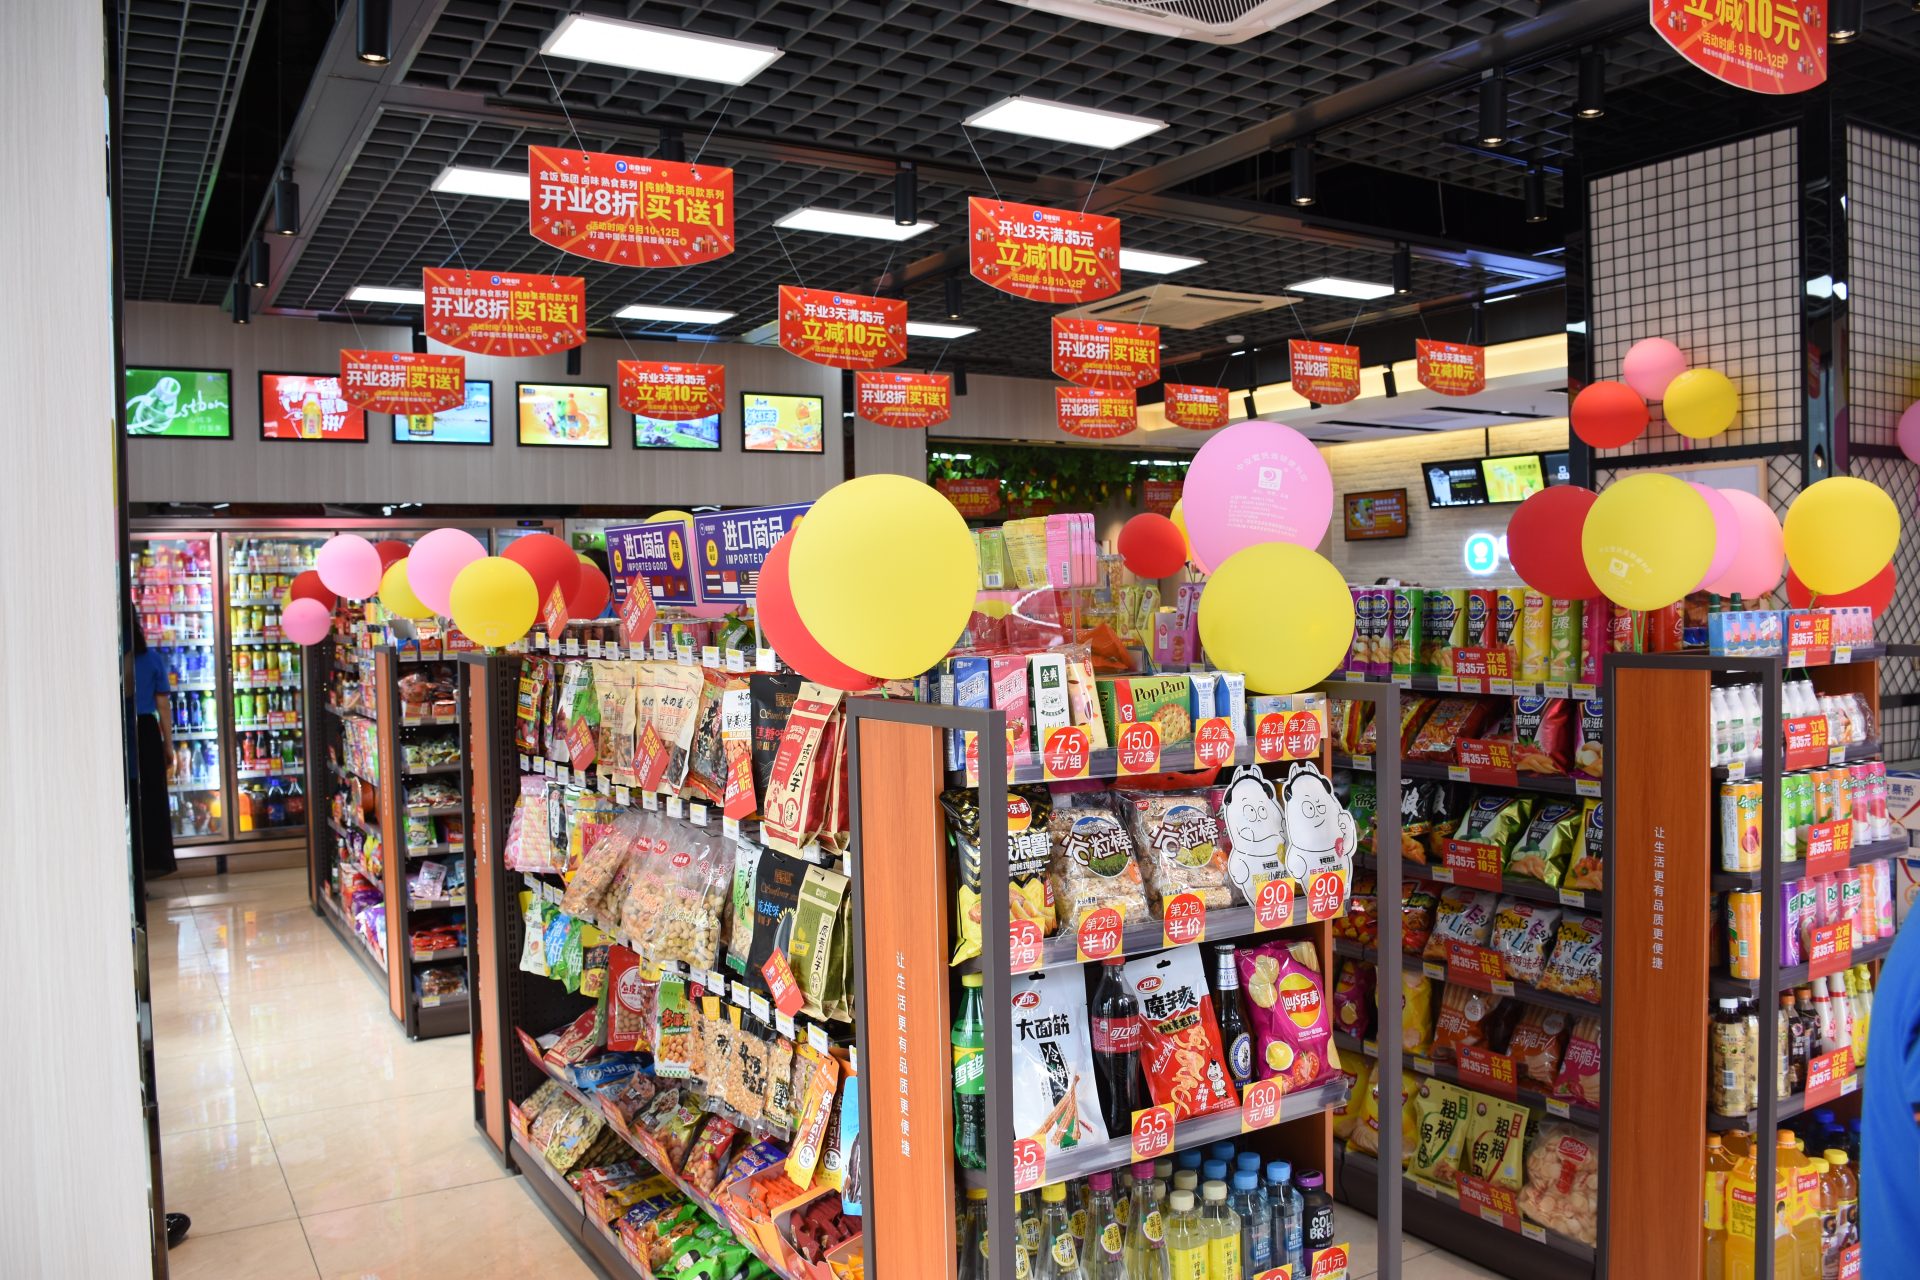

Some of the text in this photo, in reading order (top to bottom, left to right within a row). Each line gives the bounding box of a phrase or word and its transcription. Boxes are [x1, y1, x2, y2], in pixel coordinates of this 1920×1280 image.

[540, 184, 725, 227] 开业8折 买1送1
[999, 220, 1095, 248] 开业3天满35元
[996, 238, 1097, 277] 立减10元
[432, 297, 578, 324] 开业8折 买1送1
[804, 303, 885, 325] 开业3天满35元
[802, 317, 887, 348] 立减10元
[1058, 340, 1155, 364] 开业8折 买1送1
[347, 370, 460, 390] 开业8折 买1送1
[1294, 360, 1359, 381] 开业8折 买1送1
[1429, 362, 1475, 381] 立减10元
[637, 384, 707, 403] 立减10元
[862, 390, 946, 406] 开业8折 买1送1
[1061, 404, 1134, 417] 开业8折 买1送1
[1176, 402, 1220, 417] 立减10元
[723, 515, 785, 551] 进口商品
[623, 531, 666, 560] 进口商品
[627, 561, 668, 572] IMPORTED GOOD
[726, 553, 763, 565] IMPORTED
[1456, 661, 1486, 675] 满35元
[1486, 652, 1506, 665] 立减
[1486, 664, 1507, 677] 10元
[1135, 679, 1185, 702] Pop Pan
[1201, 727, 1230, 740] 第2盒
[1289, 717, 1317, 733] 第2盒
[1054, 733, 1081, 754] 7.5
[1124, 730, 1153, 751] 15.0
[1288, 733, 1317, 753] 半价
[1123, 750, 1155, 765] 元/2盒
[1200, 742, 1230, 760] 半价
[1461, 752, 1490, 766] 满35元
[1488, 744, 1509, 757] 立减
[1052, 754, 1082, 771] 元/组
[1491, 756, 1512, 769] 10元
[1447, 853, 1476, 869] 满35元
[1477, 847, 1498, 861] 立减
[1478, 860, 1498, 874] 10元
[1263, 884, 1287, 905] 9.0
[1315, 876, 1338, 897] 9.0
[1312, 894, 1339, 913] 元/包
[1652, 826, 1665, 970] 让生活更有品质更便捷
[1169, 902, 1200, 917] 第2包
[1260, 904, 1288, 923] 元/包
[1085, 915, 1117, 931] 第2包
[1168, 919, 1201, 938] 半价
[1083, 932, 1117, 952] 半价
[1451, 955, 1480, 972] 满35元
[1144, 986, 1198, 1020] 魔芋爽
[1282, 990, 1319, 1012] Lay's 乐事
[1016, 1014, 1070, 1041] 大面筋
[1460, 1057, 1491, 1077] 满35元
[1248, 1089, 1275, 1108] 13.0
[1249, 1104, 1275, 1120] 元/组
[1140, 1112, 1167, 1137] 5.5
[1138, 1131, 1168, 1152] 元/组
[1491, 1117, 1510, 1161] 粗粮
[1316, 1252, 1344, 1273] 加1元
